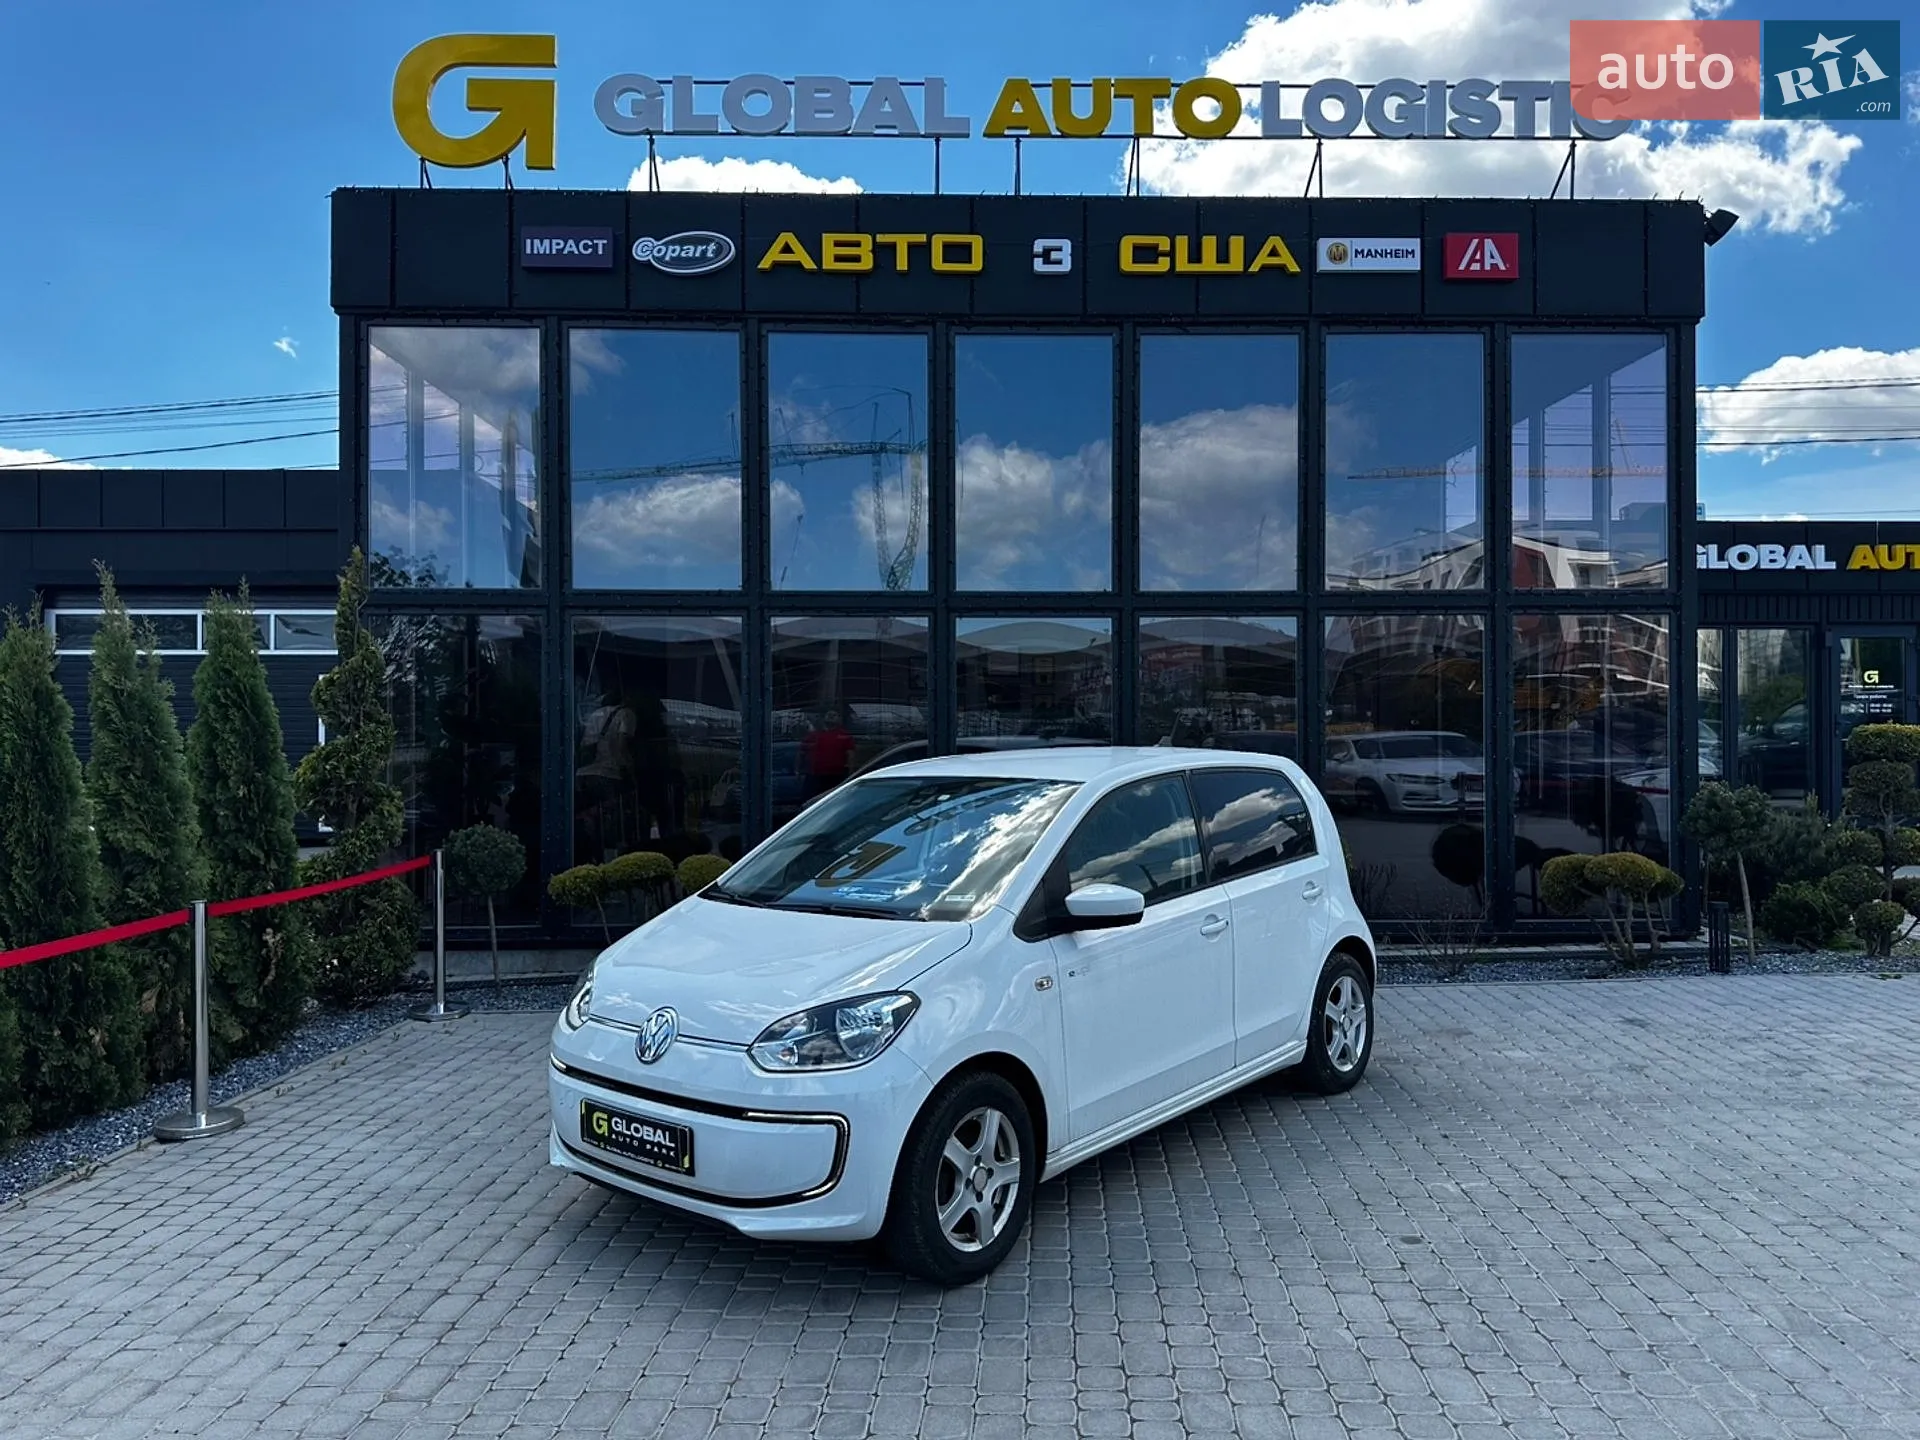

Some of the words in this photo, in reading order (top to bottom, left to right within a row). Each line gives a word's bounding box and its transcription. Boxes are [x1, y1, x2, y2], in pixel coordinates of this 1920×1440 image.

[393, 33, 557, 170] G
[594, 73, 970, 138] GLOBAL
[983, 77, 1242, 138] AUTO
[1261, 78, 1632, 140] LOGISTIC
[525, 239, 607, 255] IMPACT
[632, 238, 717, 261] Copart
[757, 232, 983, 274] АВТО
[1119, 235, 1301, 275] США
[1354, 248, 1415, 259] MANHEIM
[611, 1117, 675, 1147] GLOBAL
[611, 1133, 639, 1147] AUTO
[645, 1143, 676, 1157] PARK
